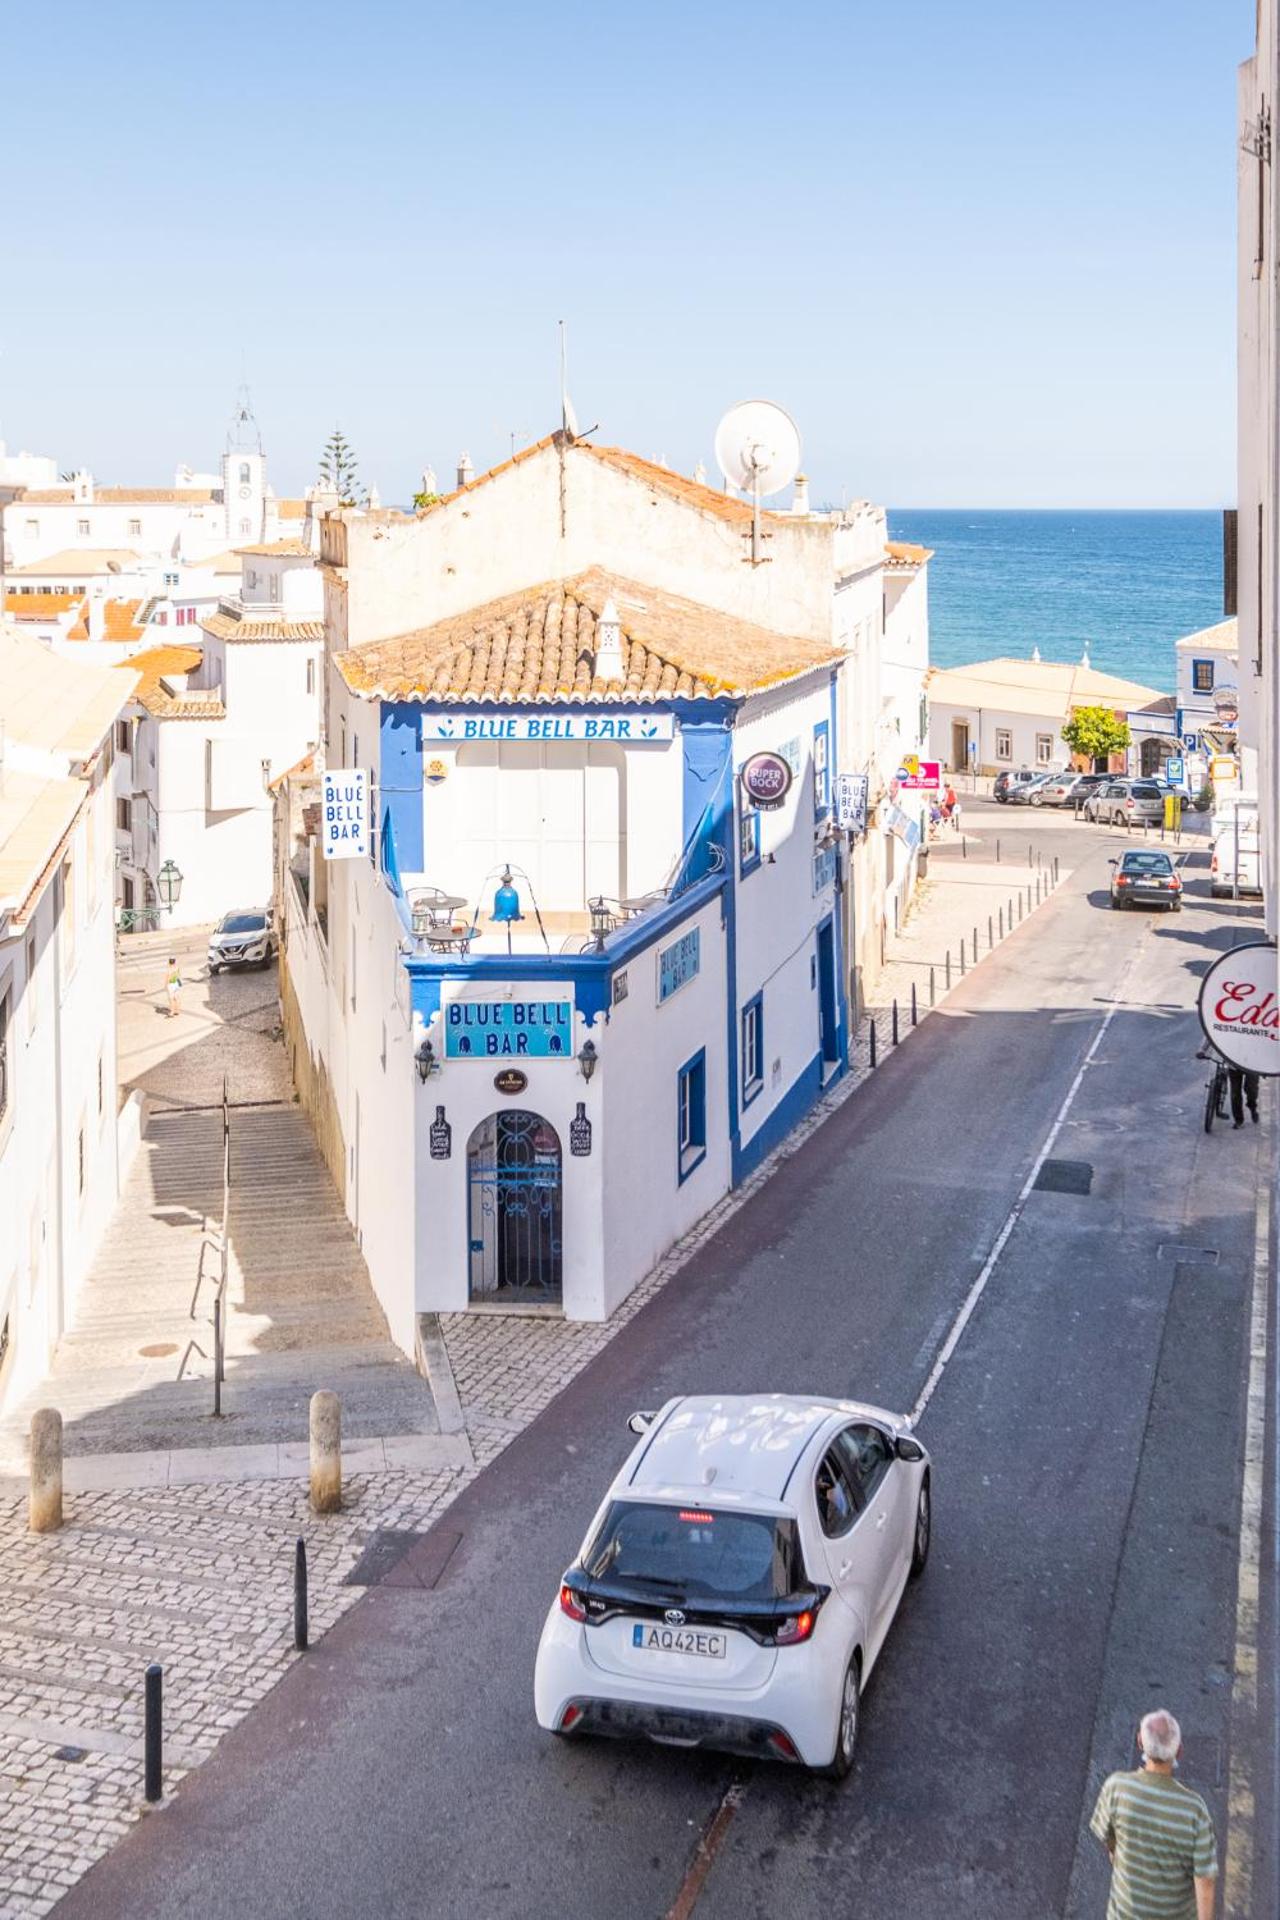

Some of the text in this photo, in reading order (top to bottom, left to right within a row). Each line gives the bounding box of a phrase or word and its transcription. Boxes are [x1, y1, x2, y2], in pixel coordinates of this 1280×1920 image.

[464, 719, 631, 738] BLUE BELL BAR
[750, 767, 781, 779] SUPER
[751, 777, 779, 789] BOCK
[326, 785, 363, 802] BLUE
[842, 785, 865, 797] BLUE
[841, 797, 864, 809] BELL
[326, 805, 363, 821] BELL
[843, 809, 862, 820] BAR
[330, 823, 360, 840] BAR
[449, 1003, 566, 1025] BLUE BELL
[1213, 1023, 1269, 1037] RESTAURANTE
[486, 1032, 528, 1055] BAR
